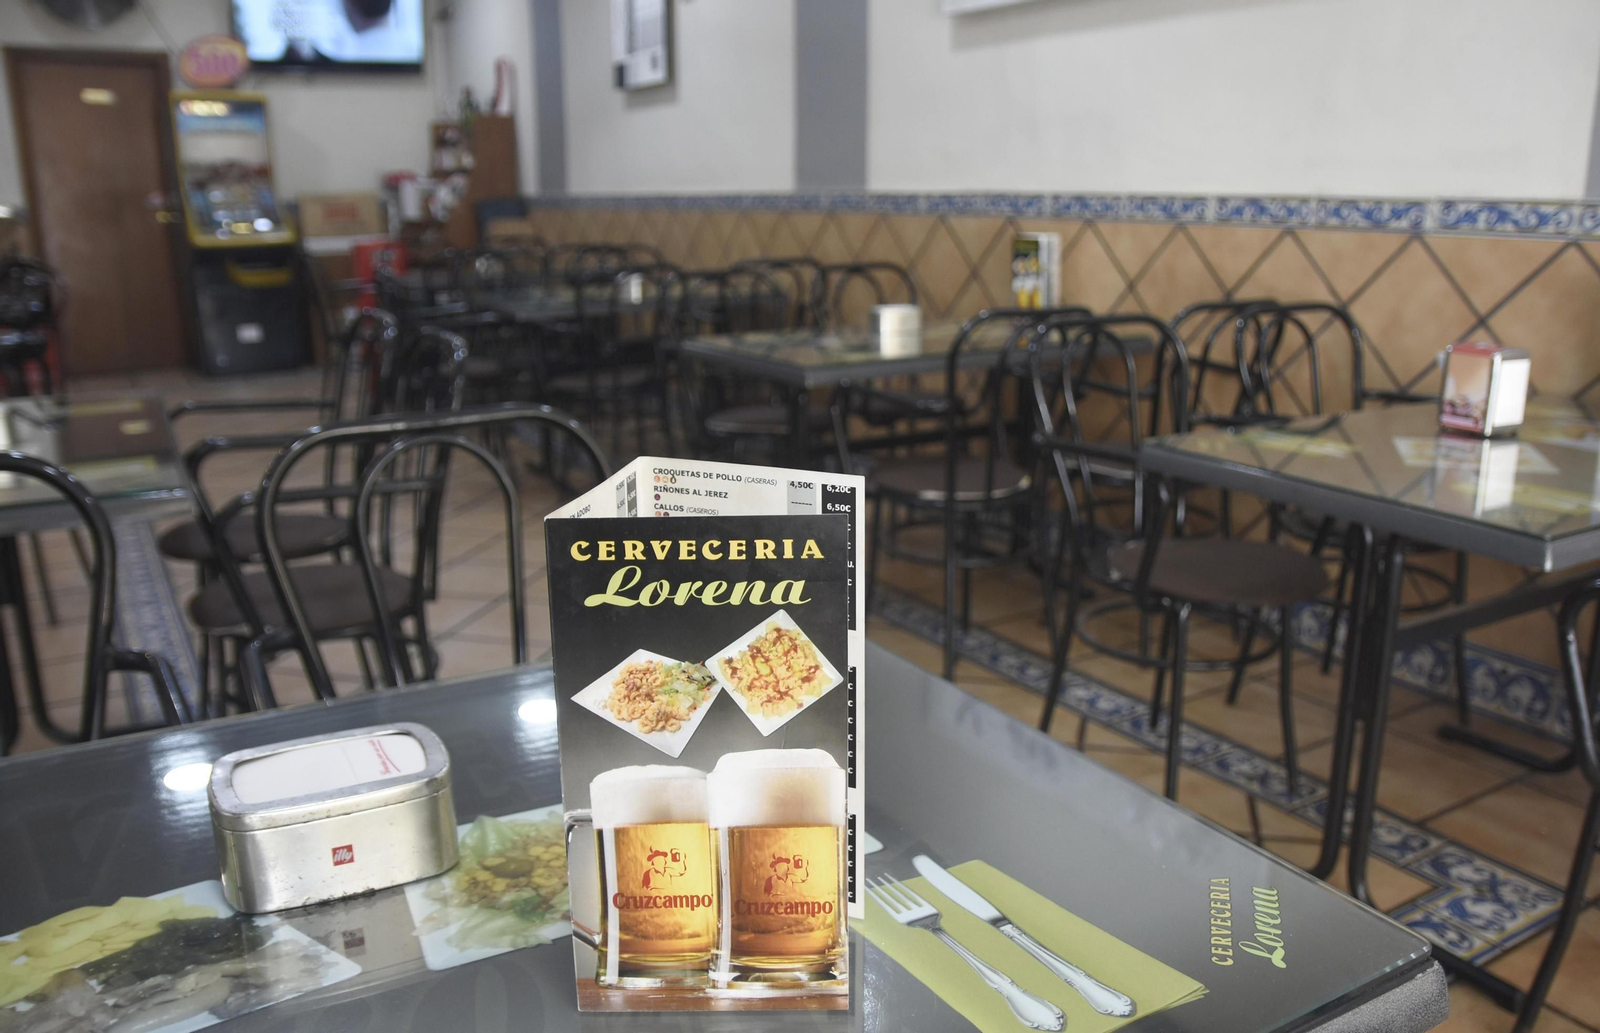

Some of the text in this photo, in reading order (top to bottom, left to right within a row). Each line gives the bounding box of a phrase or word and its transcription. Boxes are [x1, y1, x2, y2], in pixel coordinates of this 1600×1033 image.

[653, 468, 701, 478] CROQUETAS
[716, 473, 742, 482] POLLO
[744, 476, 778, 486] (CASERAS)
[653, 485, 690, 495] RIÑONES
[704, 490, 729, 499] JEREZ
[654, 503, 719, 516] CALLOS (CASEROS)
[570, 539, 824, 562] CERVECERIA
[584, 565, 812, 607] Lorena
[333, 848, 353, 863] illy
[612, 892, 713, 911] Cruzcampo
[734, 899, 834, 917] Cruzcampo
[1210, 878, 1234, 966] CERVECERIA
[1238, 886, 1287, 968] Lorena
